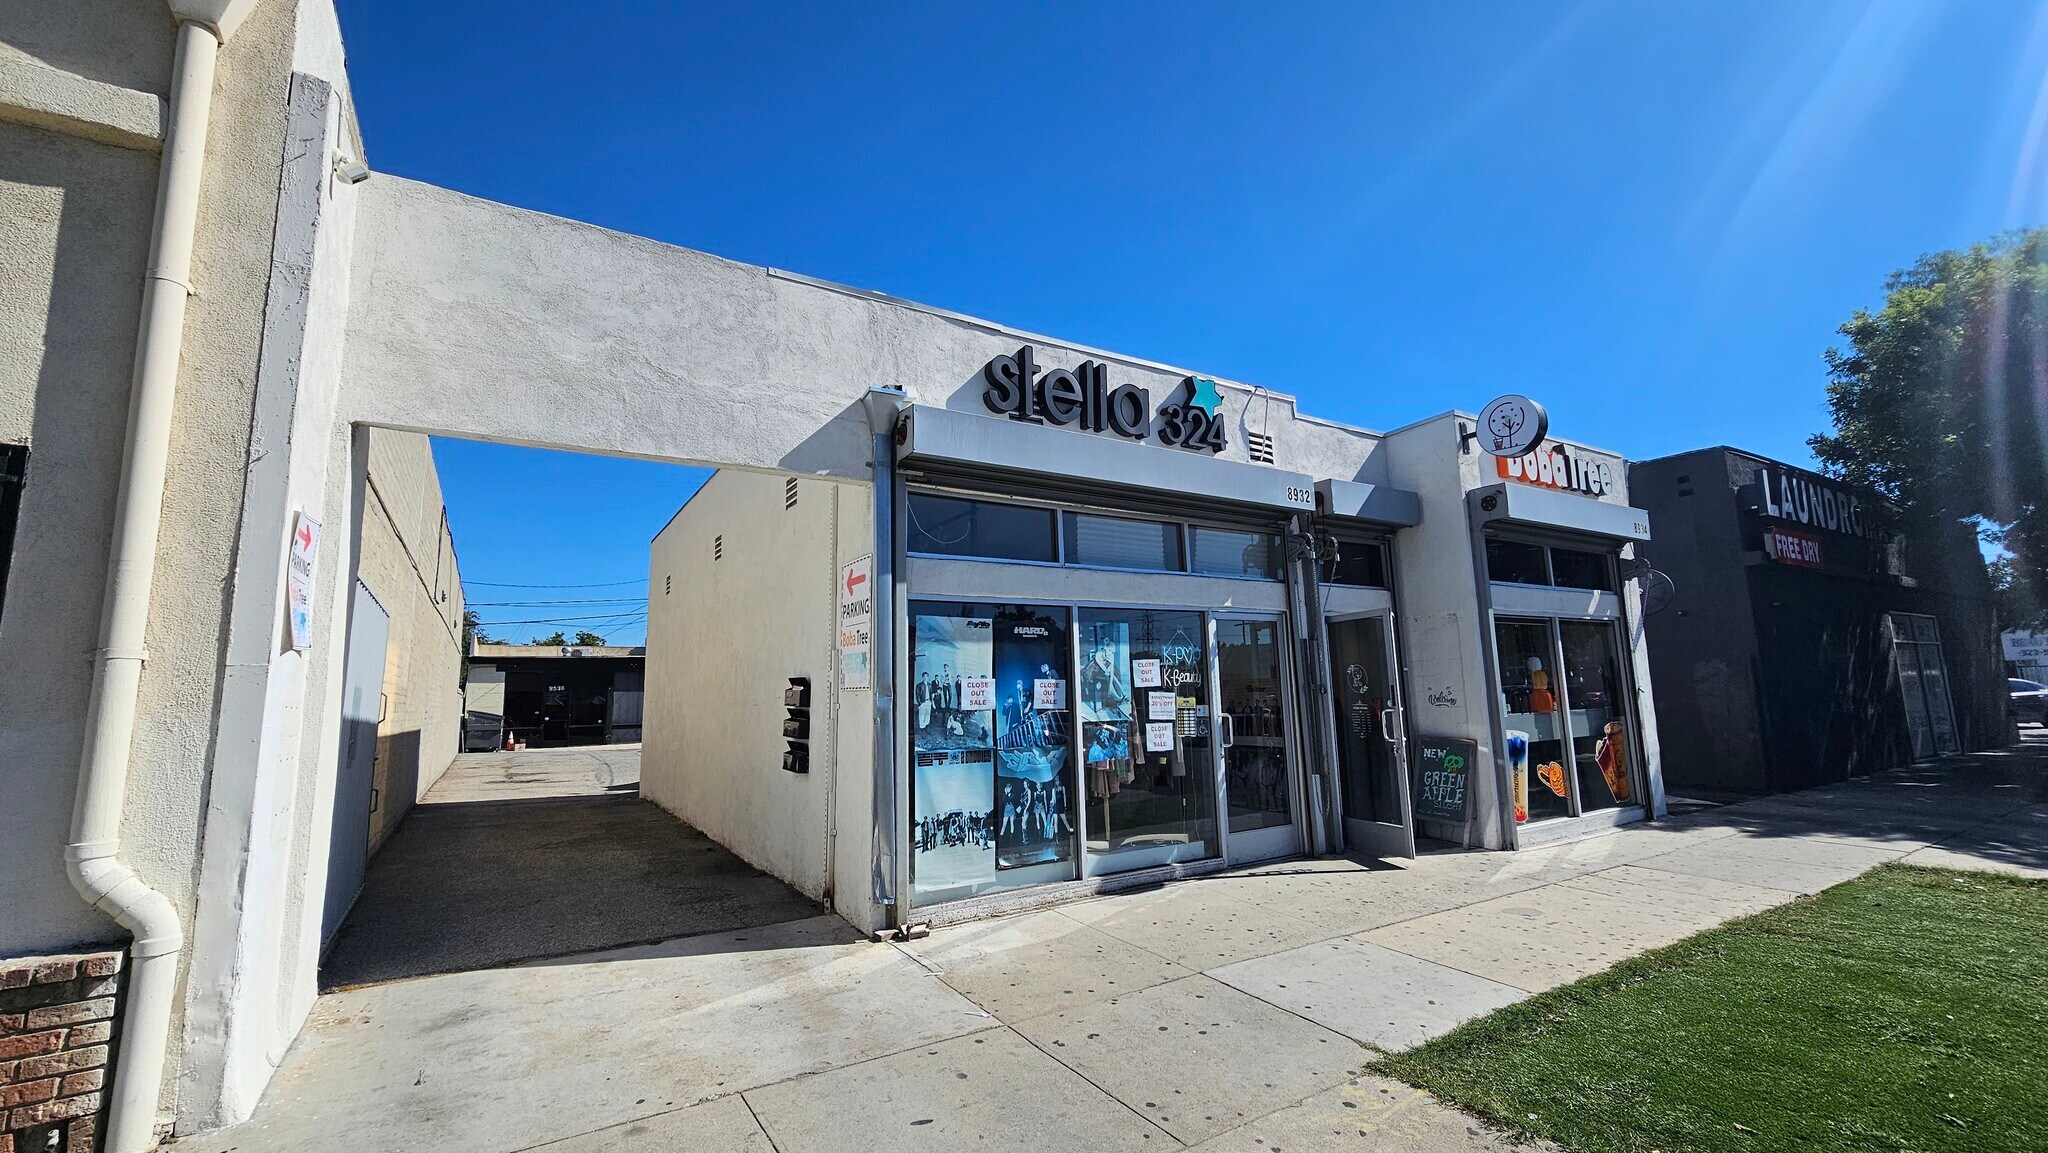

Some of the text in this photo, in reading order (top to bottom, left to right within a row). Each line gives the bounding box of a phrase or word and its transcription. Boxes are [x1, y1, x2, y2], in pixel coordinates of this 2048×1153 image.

[983, 345, 1228, 452] stella 324
[1564, 443, 1613, 495] Tree
[1287, 486, 1311, 504] 8932
[1762, 469, 1887, 543] LAUNDRO
[1633, 522, 1648, 535] 8934
[1775, 533, 1820, 564] FREE DRY
[291, 551, 310, 577] PARKING
[842, 598, 869, 619] PARKING
[842, 629, 868, 648] Boba Tree
[1014, 626, 1044, 635] HARD
[1163, 668, 1201, 688] K-Beauty
[1423, 748, 1447, 759] NEW
[1424, 771, 1466, 788] GREEN
[1422, 786, 1464, 804] APPLE
